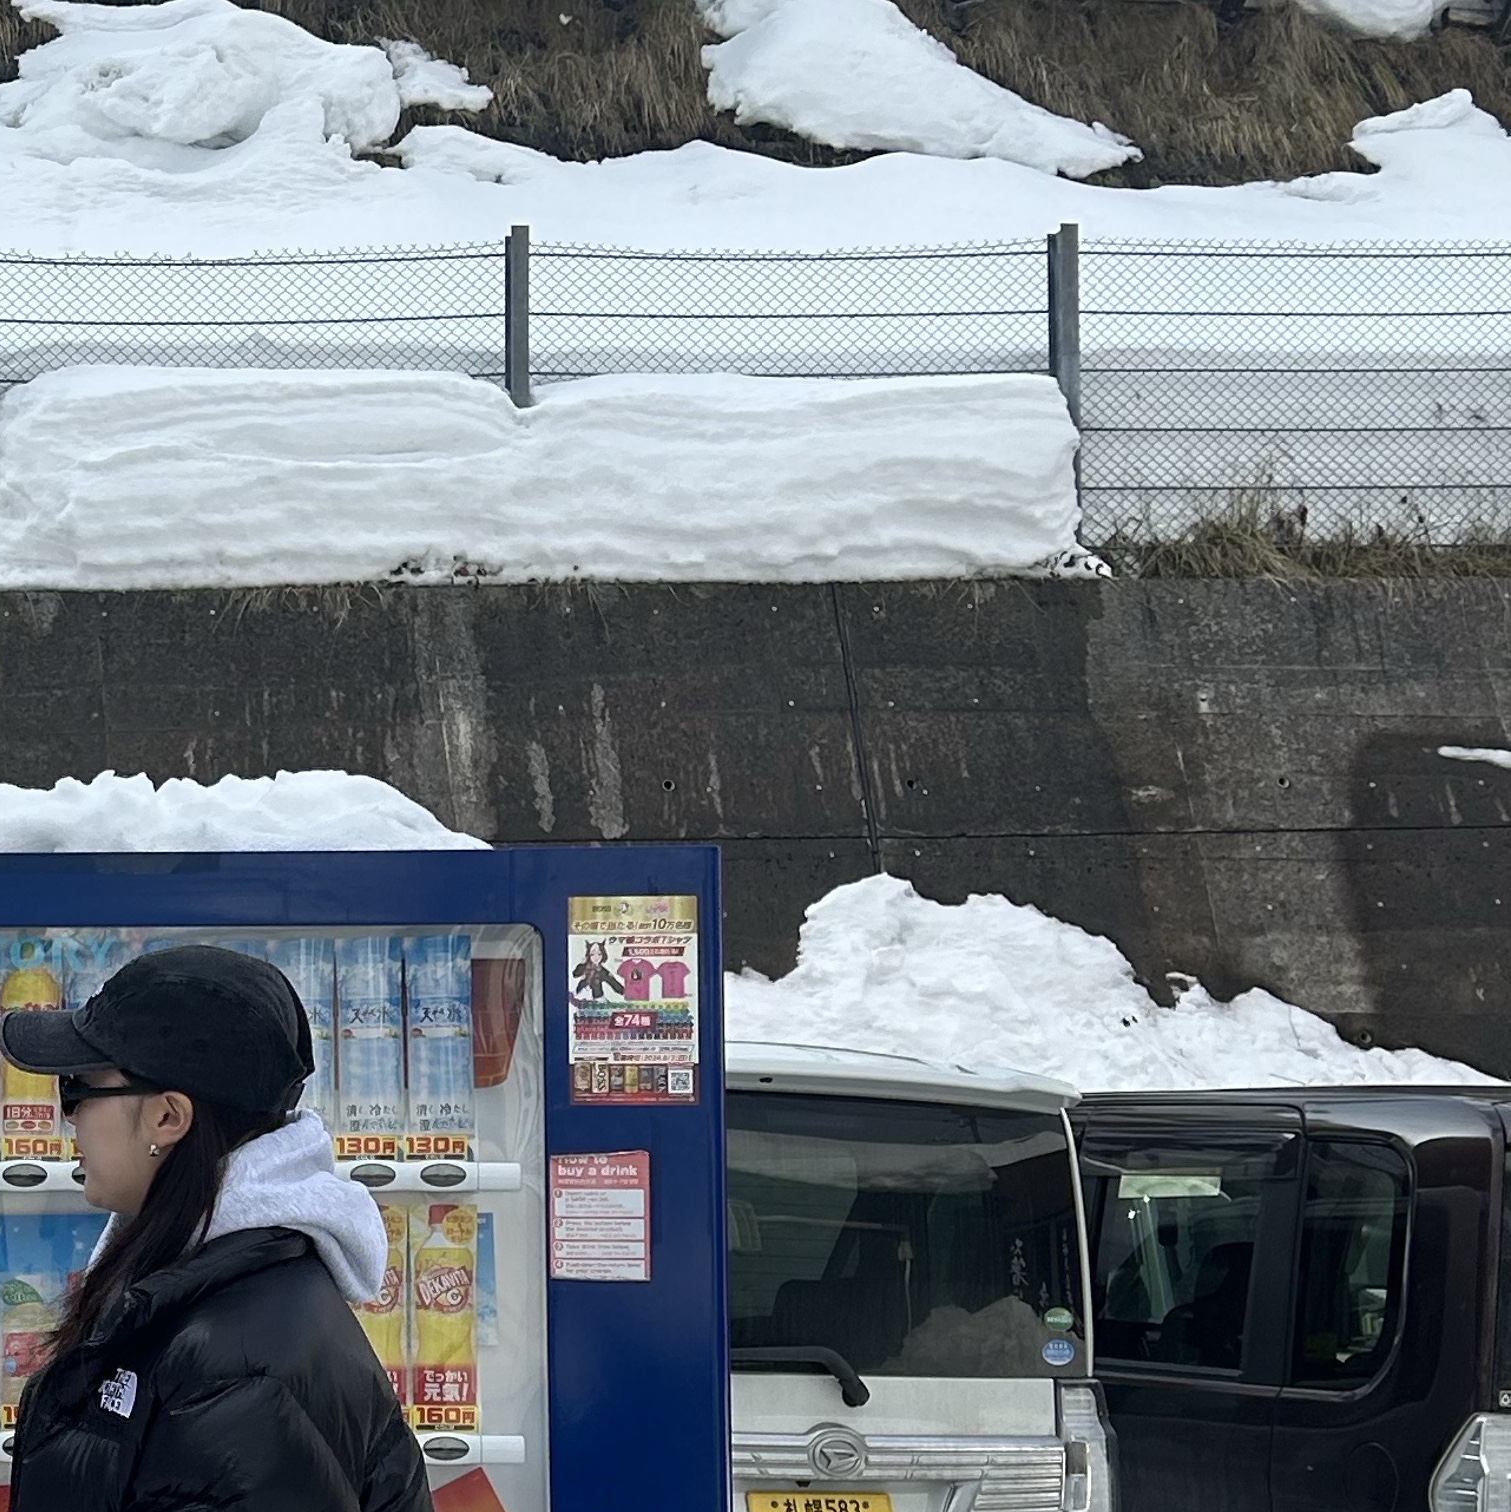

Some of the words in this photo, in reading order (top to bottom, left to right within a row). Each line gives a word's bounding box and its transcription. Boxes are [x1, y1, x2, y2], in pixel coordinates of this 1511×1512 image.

[4, 1138, 63, 1155] 160円
[335, 1137, 396, 1154] 130円
[405, 1137, 466, 1154] 130円
[557, 1165, 585, 1177] buy
[588, 1168, 597, 1176] a
[600, 1164, 639, 1176] drink
[418, 1268, 471, 1306] DEKAVITA
[423, 1370, 468, 1383] でっかい
[424, 1382, 469, 1402] 元気!
[416, 1407, 475, 1425] 160円
